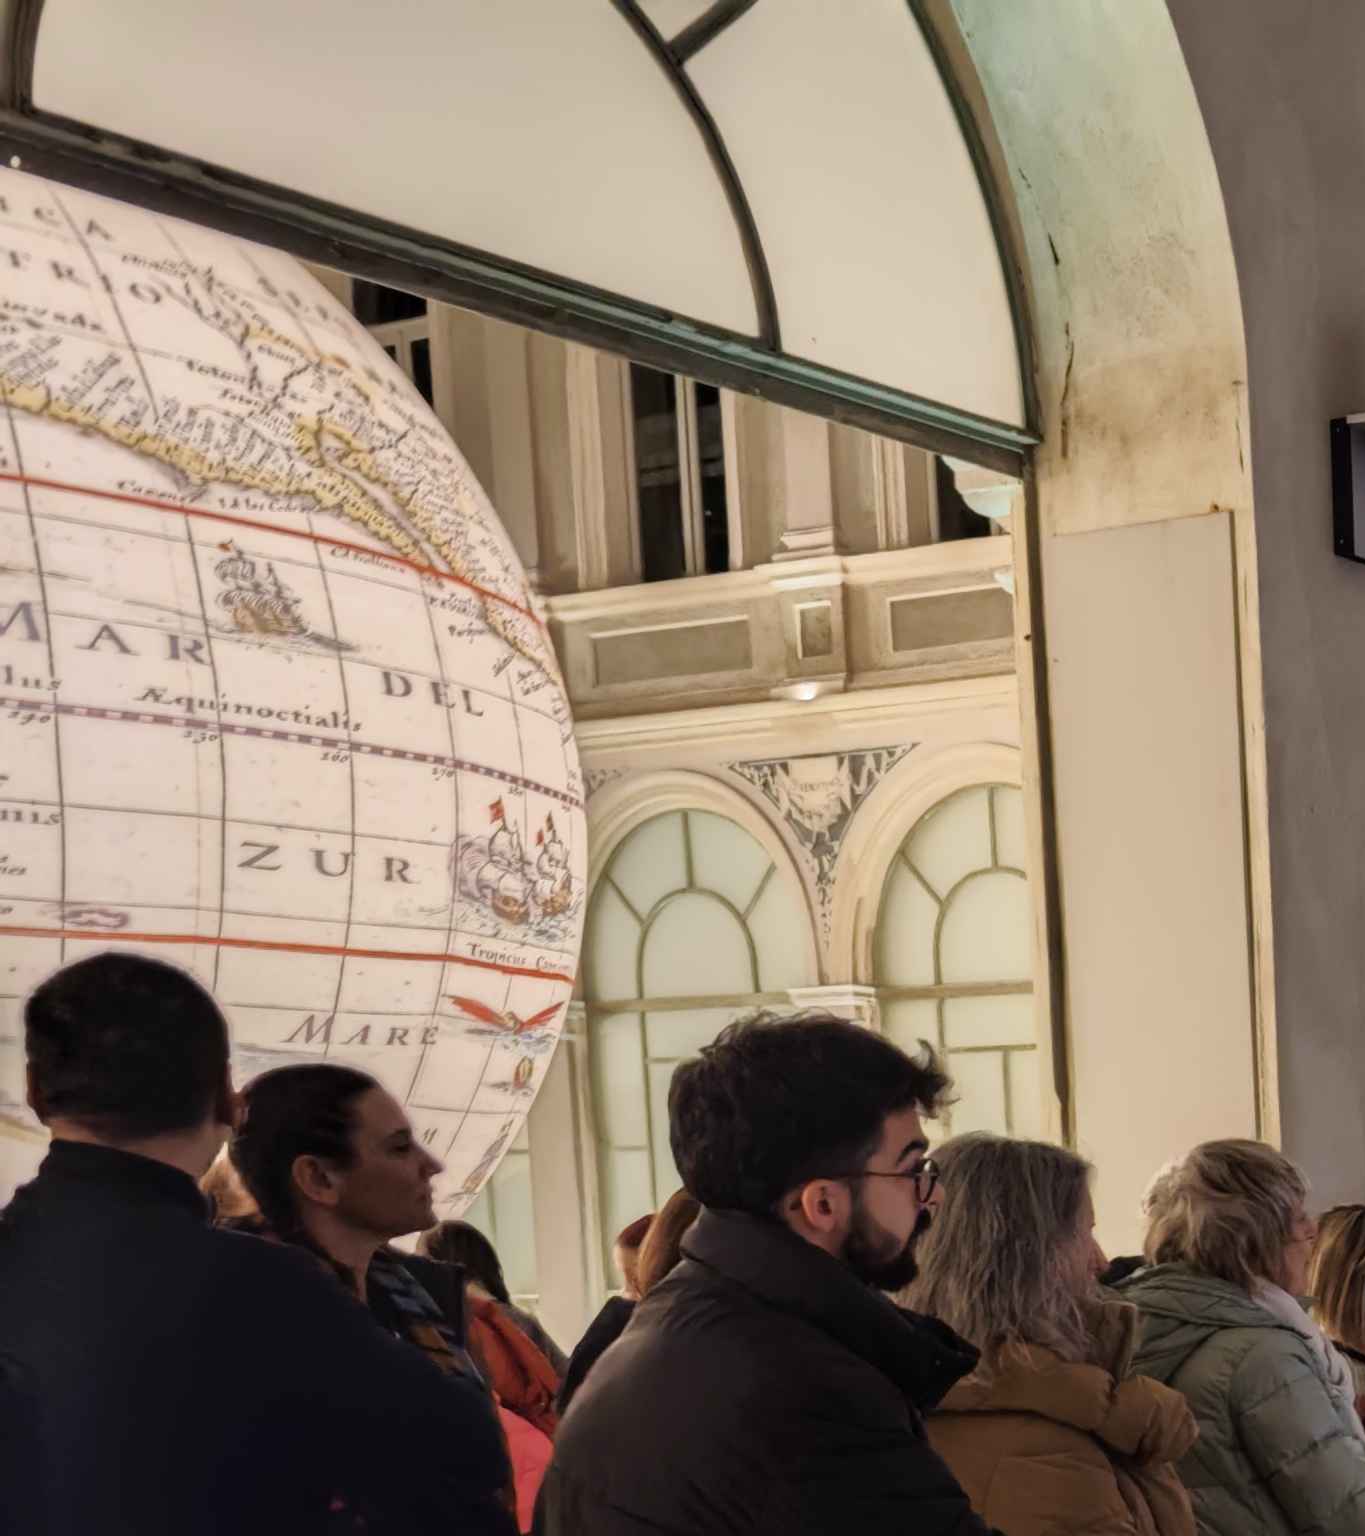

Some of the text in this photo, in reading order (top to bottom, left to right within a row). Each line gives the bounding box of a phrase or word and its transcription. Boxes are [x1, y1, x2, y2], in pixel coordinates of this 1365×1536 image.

[380, 670, 484, 717] DEL
[236, 841, 421, 885] ZUR
[280, 1013, 439, 1046] MARE
